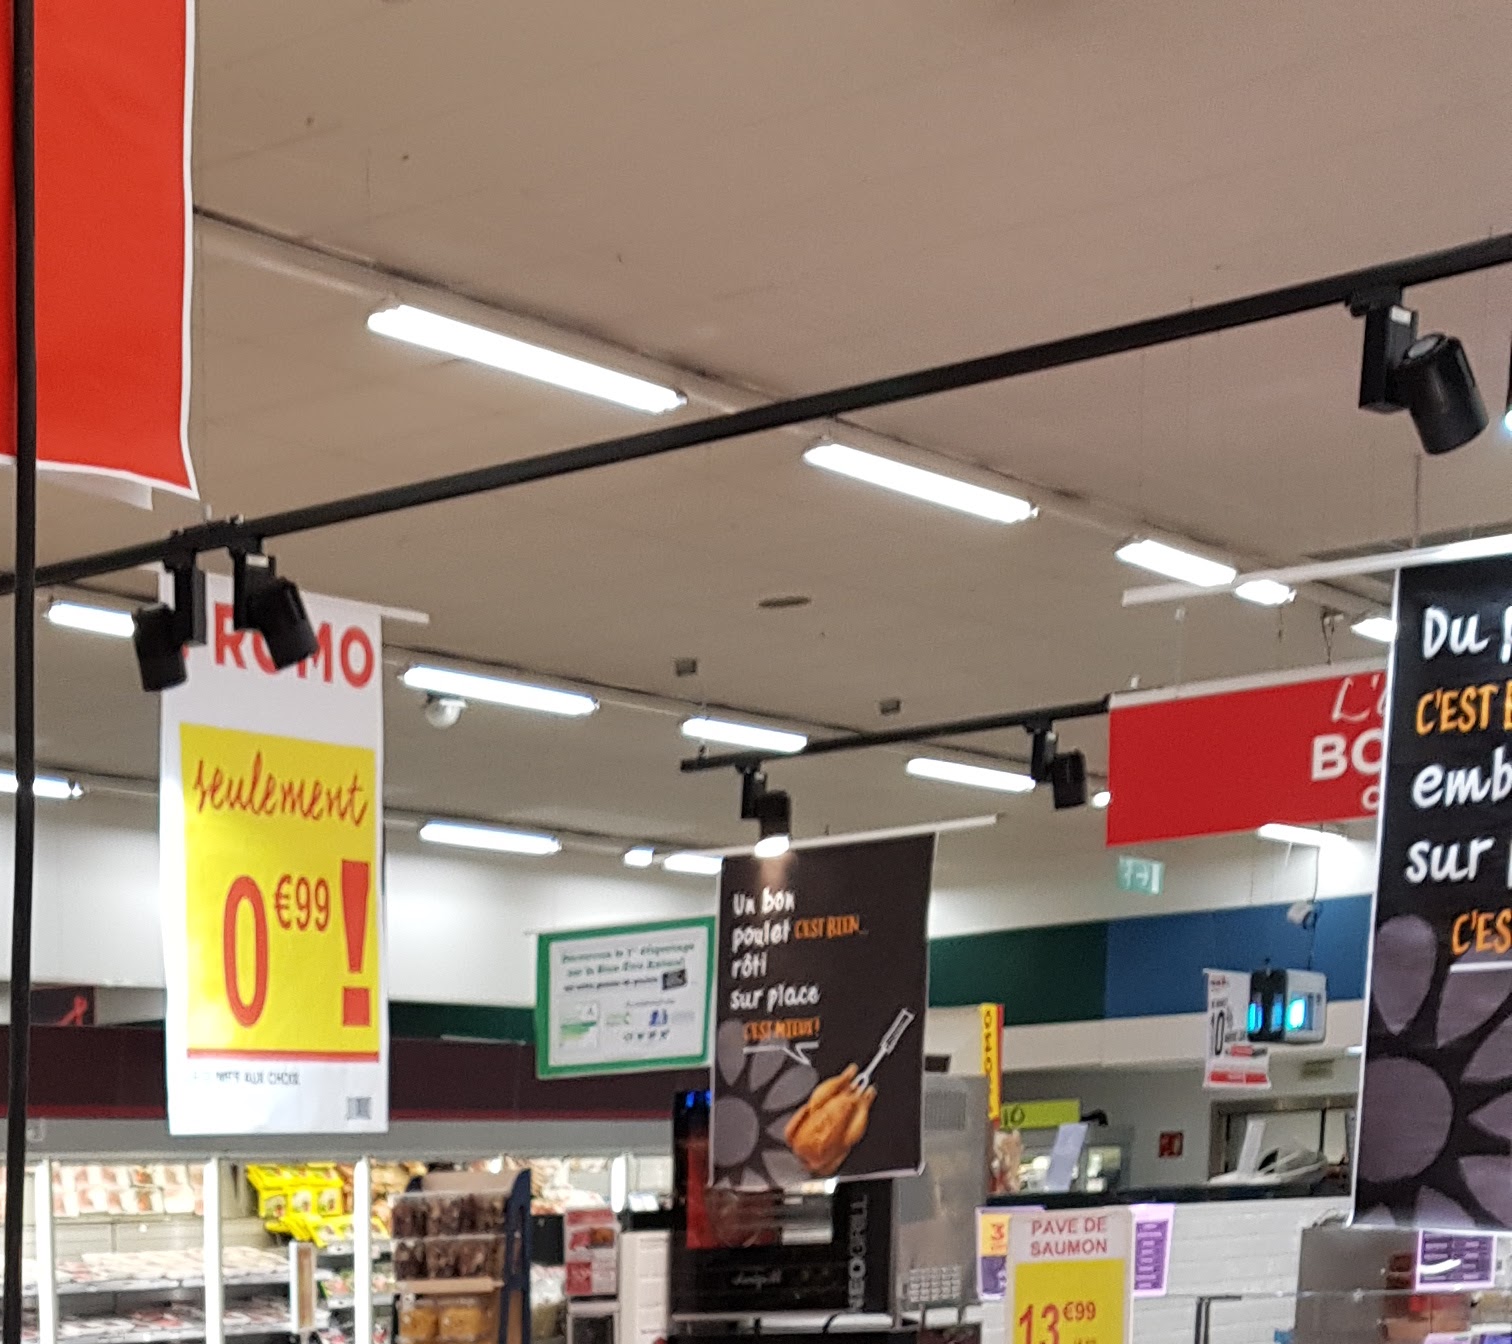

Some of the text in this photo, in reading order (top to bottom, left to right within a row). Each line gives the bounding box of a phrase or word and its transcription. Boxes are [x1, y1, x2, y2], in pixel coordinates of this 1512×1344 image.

[1421, 605, 1491, 660] Du
[1414, 682, 1500, 736] C'EST
[194, 750, 370, 828] seulement
[1404, 838, 1496, 884] sur
[730, 983, 821, 1013] sur place
[1031, 1216, 1107, 1236] PAVE DE
[1031, 1239, 1108, 1257] SAUMON
